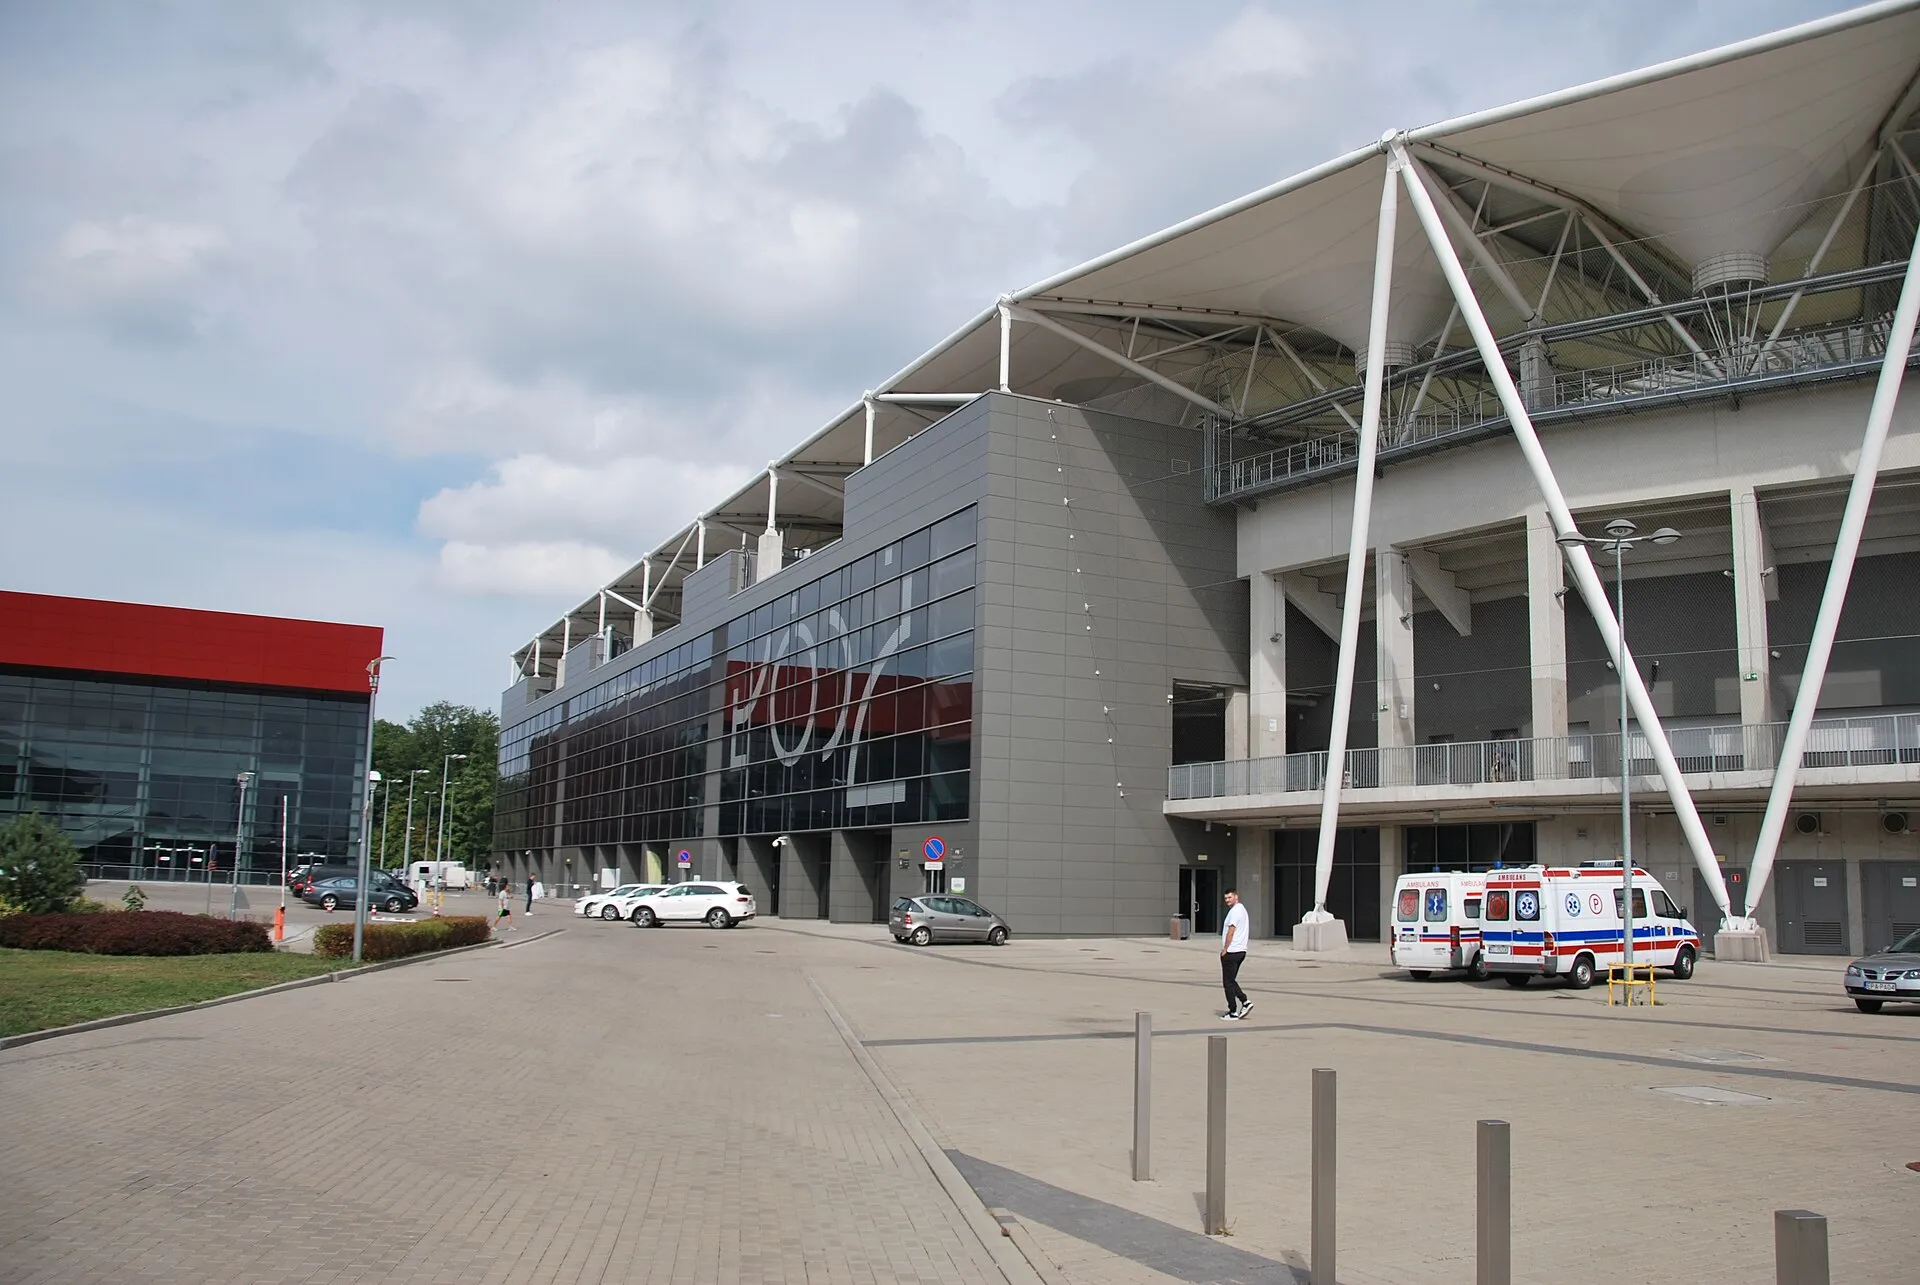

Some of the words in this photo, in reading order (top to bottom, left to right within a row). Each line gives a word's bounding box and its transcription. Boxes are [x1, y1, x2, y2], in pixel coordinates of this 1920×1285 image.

[1498, 873, 1526, 881] AMBULANS
[1407, 880, 1440, 888] AMBULANS
[1593, 898, 1599, 910] P
